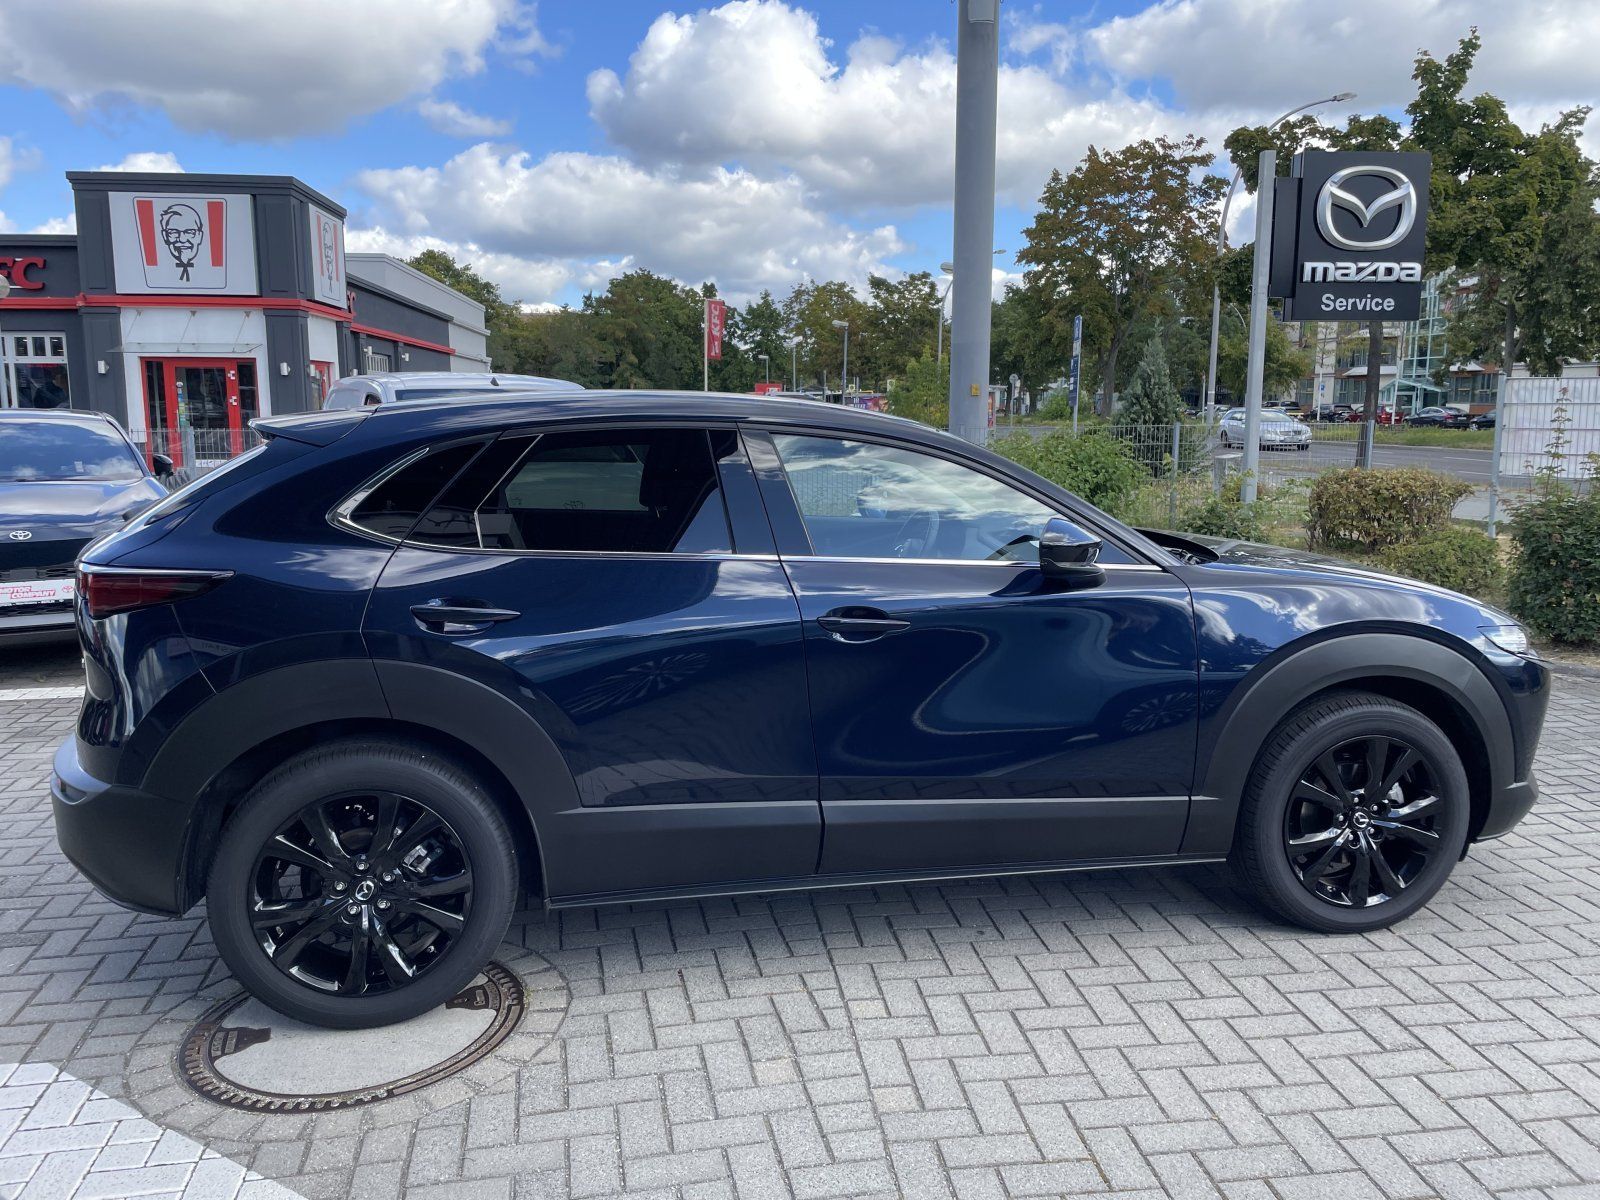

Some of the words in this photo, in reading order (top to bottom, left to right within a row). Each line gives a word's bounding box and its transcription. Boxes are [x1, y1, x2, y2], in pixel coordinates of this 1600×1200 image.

[1321, 293, 1395, 311] Service
[711, 303, 720, 338] KFC
[11, 590, 56, 599] COMPANY
